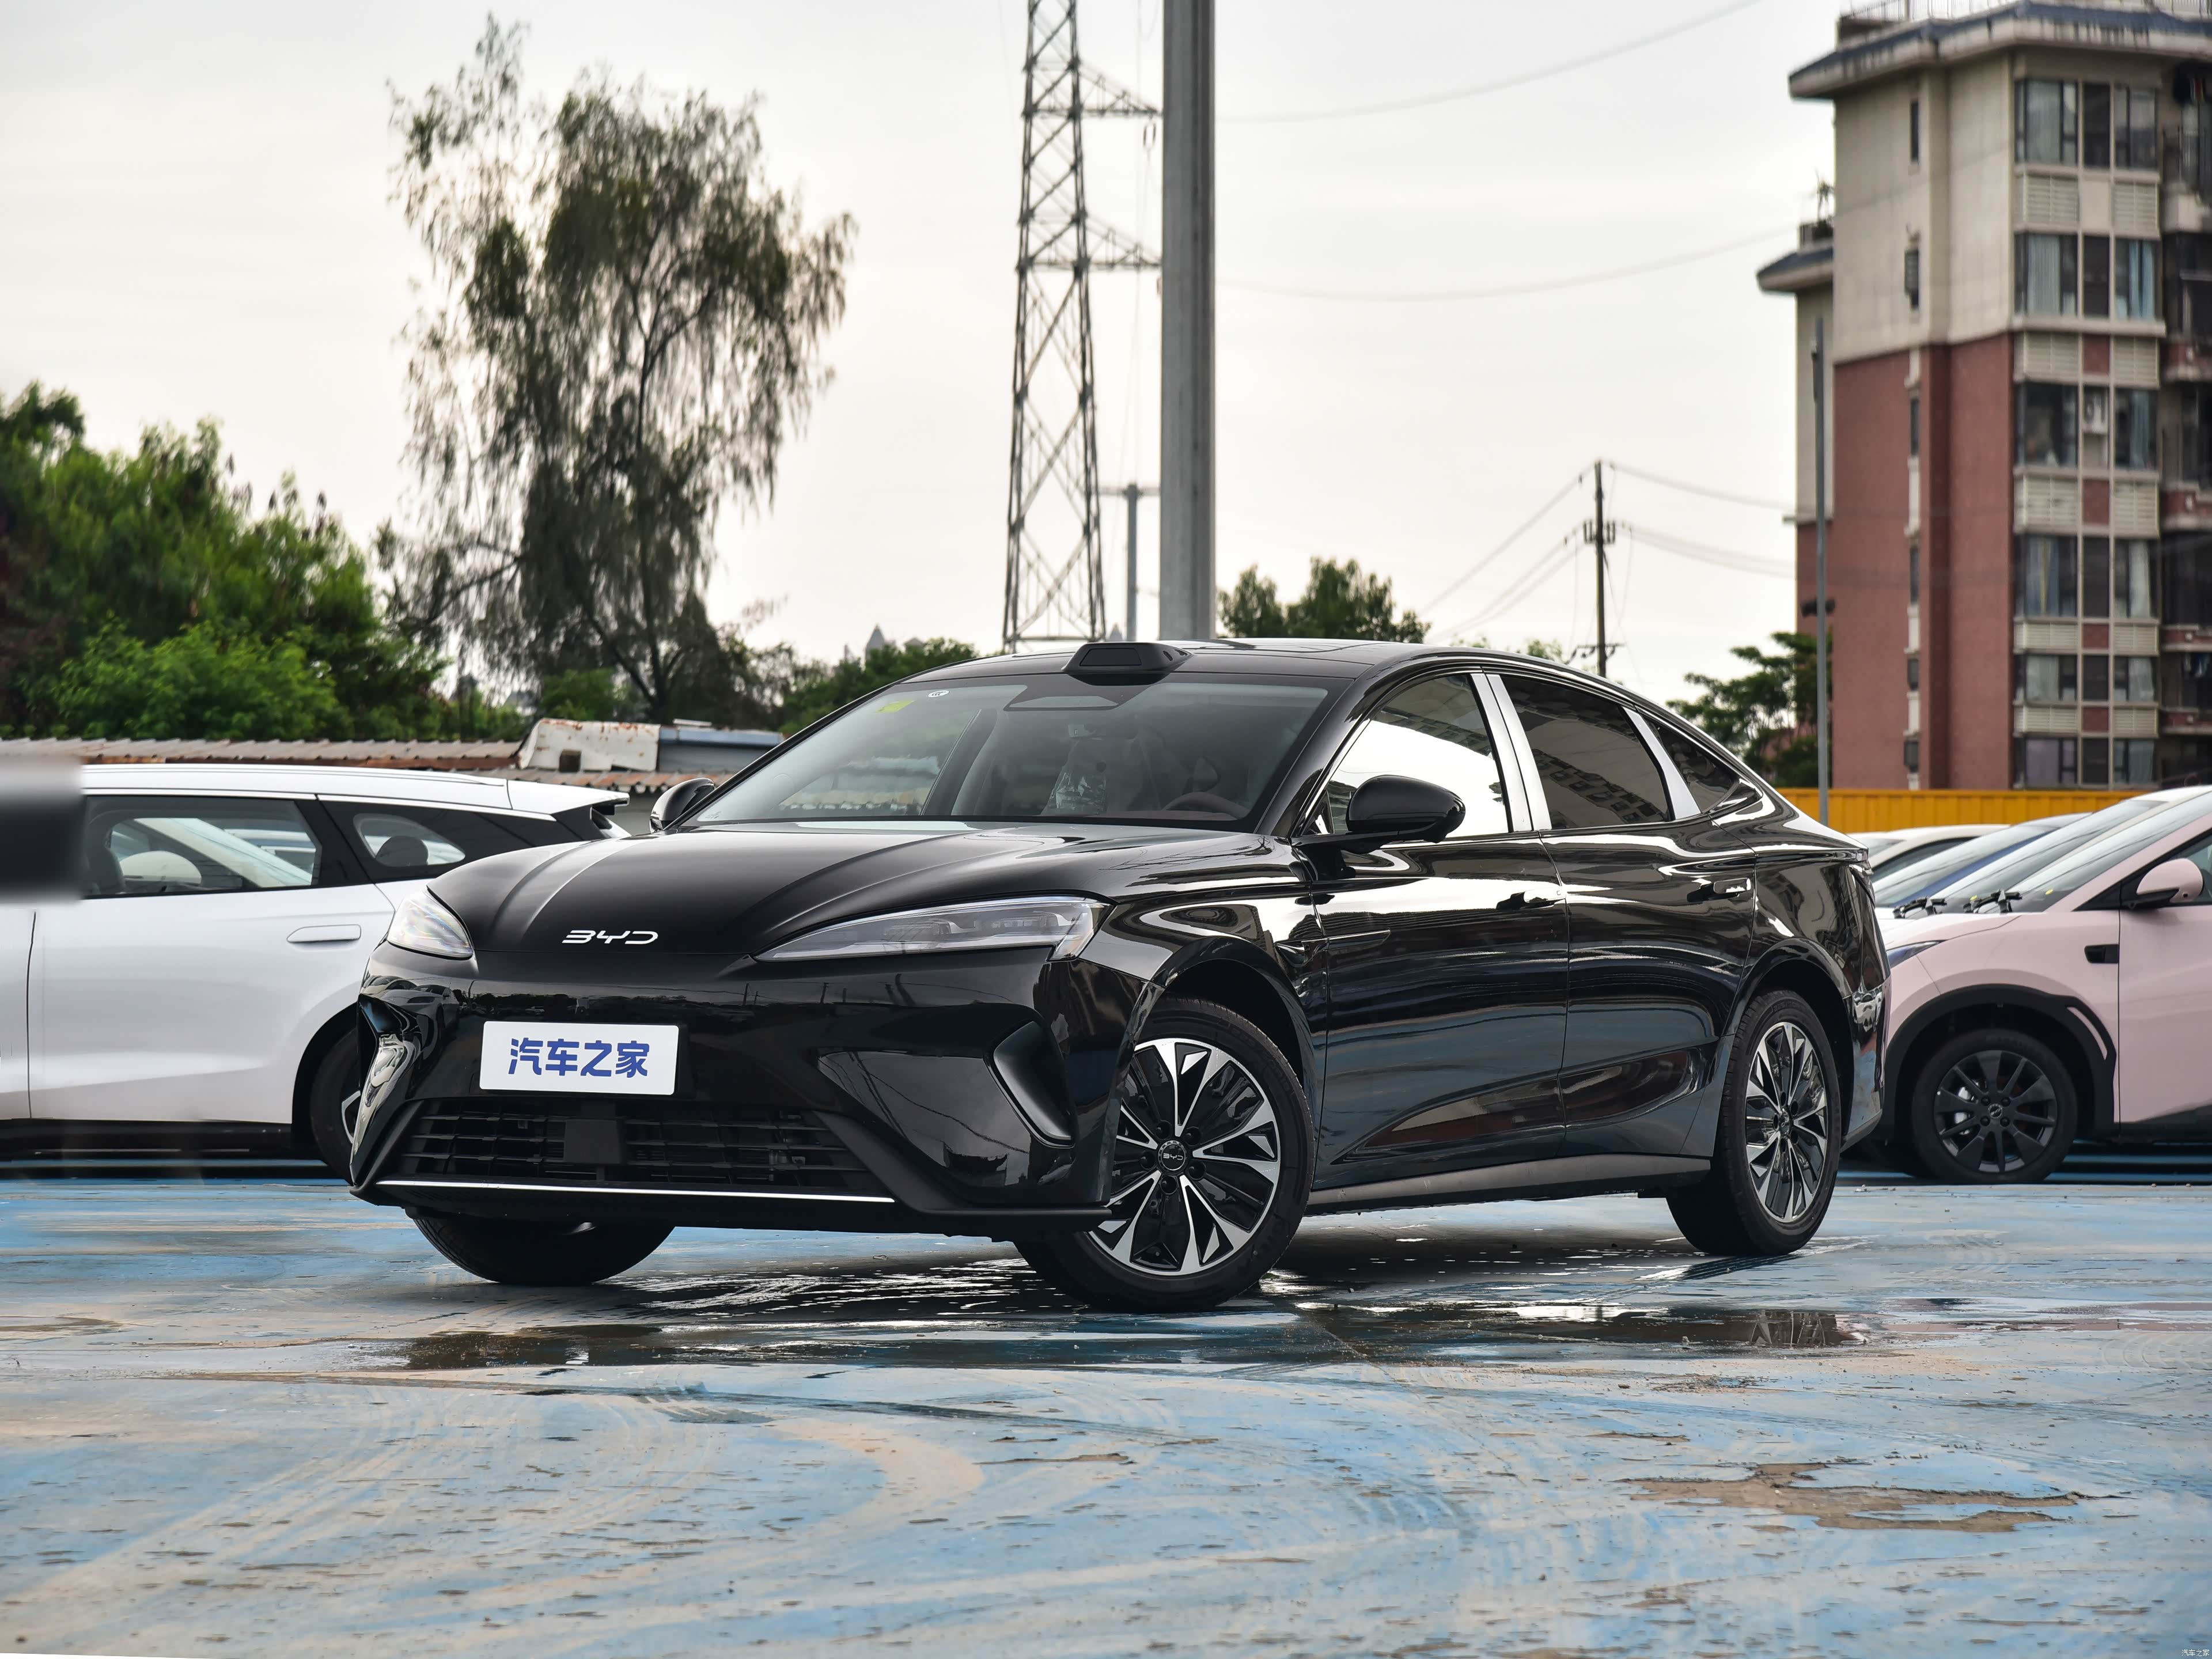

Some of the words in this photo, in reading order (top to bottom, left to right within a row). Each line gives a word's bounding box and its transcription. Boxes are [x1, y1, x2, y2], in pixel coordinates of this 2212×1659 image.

[562, 930, 658, 945] BYD
[509, 1037, 650, 1078] 汽车之家
[1162, 1153, 1184, 1161] BYD
